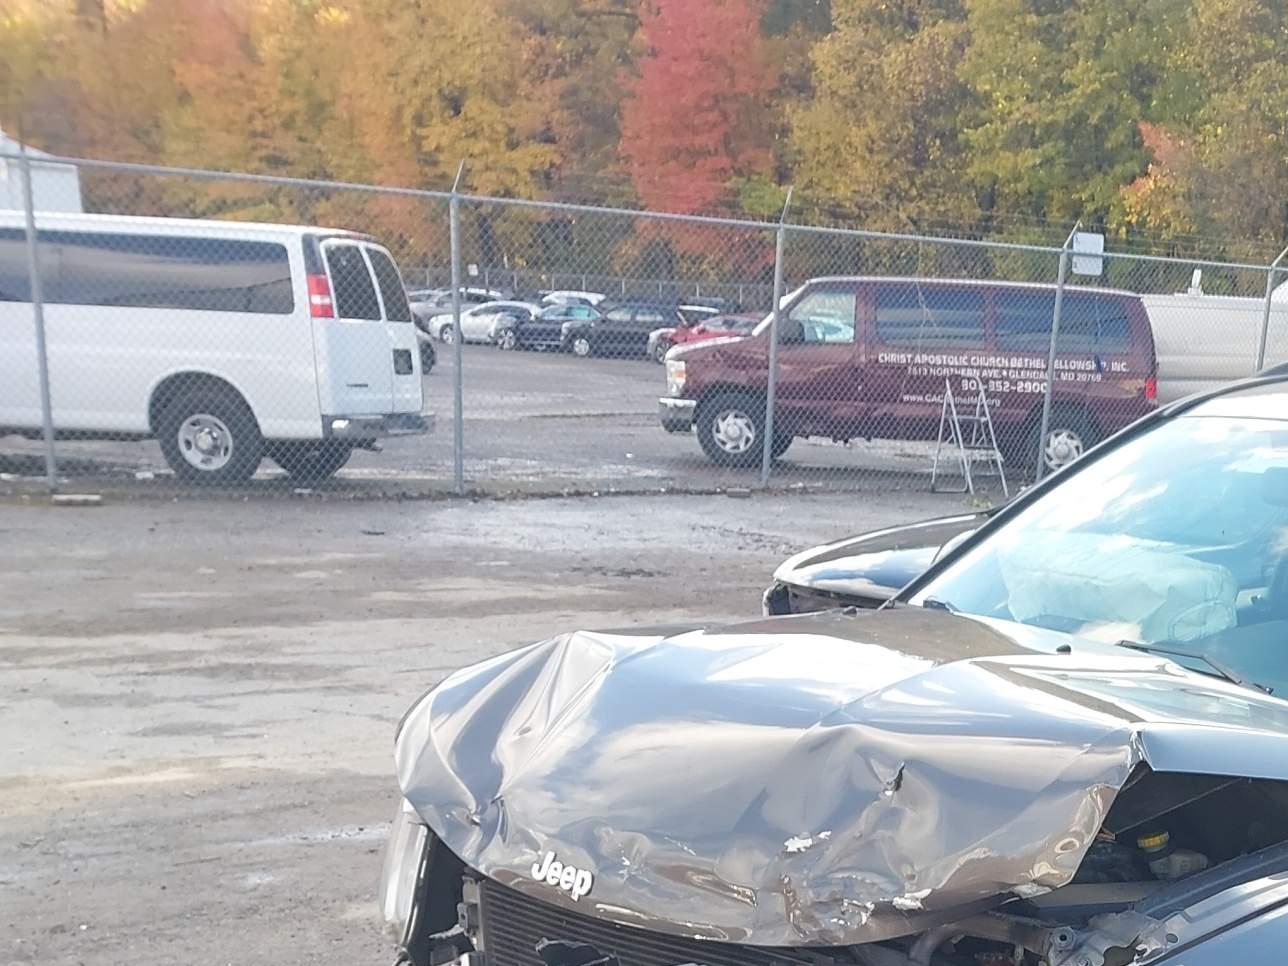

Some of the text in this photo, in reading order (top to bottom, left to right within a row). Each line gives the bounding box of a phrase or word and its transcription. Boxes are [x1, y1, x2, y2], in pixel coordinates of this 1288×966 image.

[878, 352, 912, 365] CHRIST
[914, 353, 969, 366] APOSTOLIC
[970, 355, 1009, 368] CHURCH
[1010, 356, 1046, 369] BETHEL
[531, 850, 593, 902] Jeep
